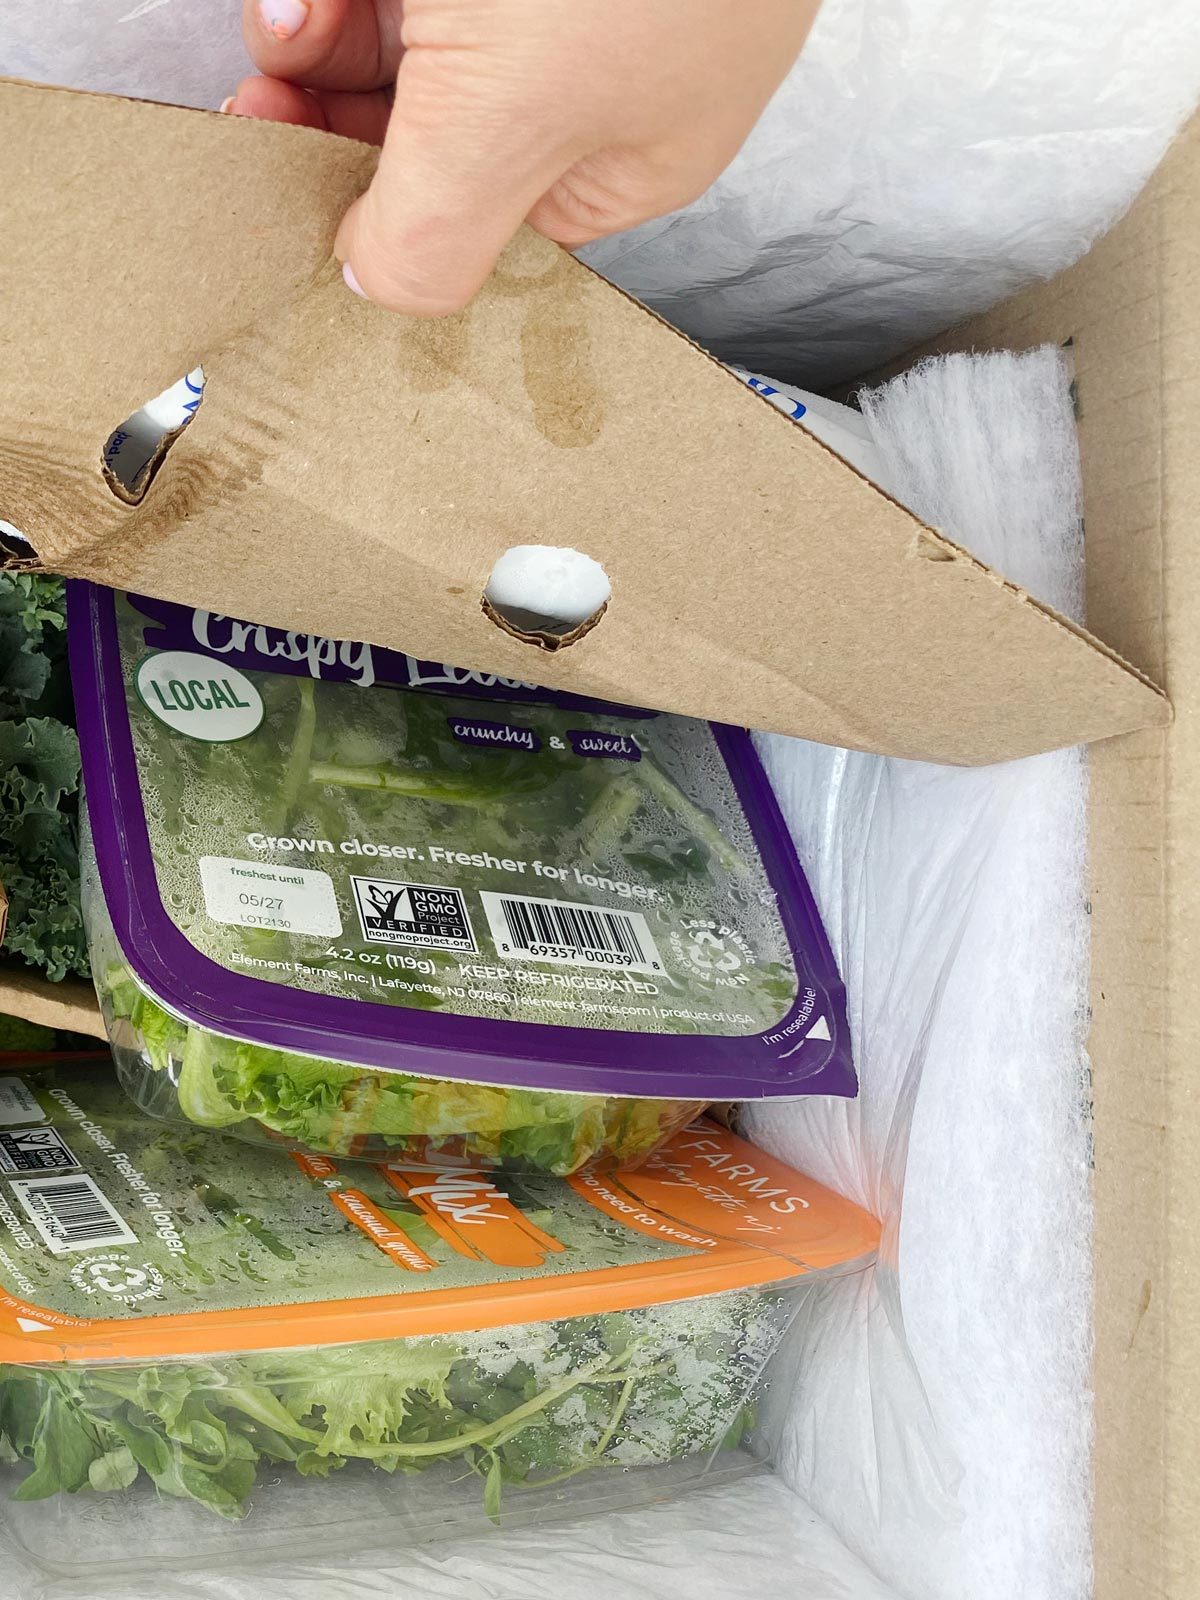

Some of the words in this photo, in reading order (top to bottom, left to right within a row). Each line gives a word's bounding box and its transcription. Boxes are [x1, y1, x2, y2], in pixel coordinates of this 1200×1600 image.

[192, 608, 375, 687] Crispy
[150, 679, 250, 711] LOCAL
[454, 724, 533, 749] crunchy
[550, 736, 565, 750] &
[580, 737, 631, 754] sweet
[230, 867, 276, 882] freshest
[279, 874, 304, 885] until
[247, 832, 335, 853] Grown
[340, 838, 425, 861] closer.
[428, 846, 527, 874] Fresher
[531, 861, 568, 881] for
[574, 868, 666, 902] longer.
[239, 893, 284, 910] 05/27
[413, 890, 454, 904] NON
[415, 902, 457, 915] GMO
[240, 914, 291, 929] LOT2130
[372, 918, 463, 937] VERIFIED
[418, 912, 460, 925] Project
[368, 930, 471, 949] nongmoproject.org
[680, 919, 716, 930] Less
[718, 926, 758, 965] plastic
[502, 943, 510, 952] 8
[529, 944, 577, 960] 69357
[585, 950, 632, 966] 00039
[652, 961, 661, 970] 8
[325, 946, 356, 962] 4.2
[359, 954, 382, 966] oz
[385, 954, 437, 976] (119g)
[458, 963, 511, 981] KEEP
[515, 969, 659, 996] REFRIGERATED
[715, 972, 751, 986] New
[231, 952, 292, 972] Element
[294, 963, 342, 981] Farms,
[344, 970, 369, 984] Inc.
[379, 976, 446, 997] Lafayette,
[447, 986, 465, 998] NJ
[467, 988, 511, 1004] 07860
[520, 994, 650, 1016] element-farms.com
[660, 1004, 707, 1021] product
[708, 1009, 725, 1022] of
[726, 1013, 756, 1024] USA
[761, 1033, 783, 1046] I'm
[782, 987, 817, 1037] resealable!
[0, 1134, 29, 1169] VERIFIED
[37, 1150, 54, 1167] GMO
[50, 1149, 69, 1165] NON
[49, 1089, 86, 1120] Grown
[80, 1121, 116, 1153] closer.
[107, 1152, 151, 1191] Fresher
[139, 1192, 163, 1209] for
[151, 1210, 187, 1257] longer.
[679, 1140, 810, 1213] FARMS
[388, 1163, 509, 1225] Mix
[338, 1192, 400, 1240] seasonal
[380, 1235, 432, 1270] greens
[593, 1188, 640, 1213] need
[633, 1209, 657, 1226] to
[658, 1224, 718, 1247] wash
[18, 1279, 36, 1295] USA
[70, 1274, 97, 1294] New
[142, 1262, 164, 1284] Less
[0, 1296, 17, 1307] I'm
[17, 1306, 91, 1327] resealable!
